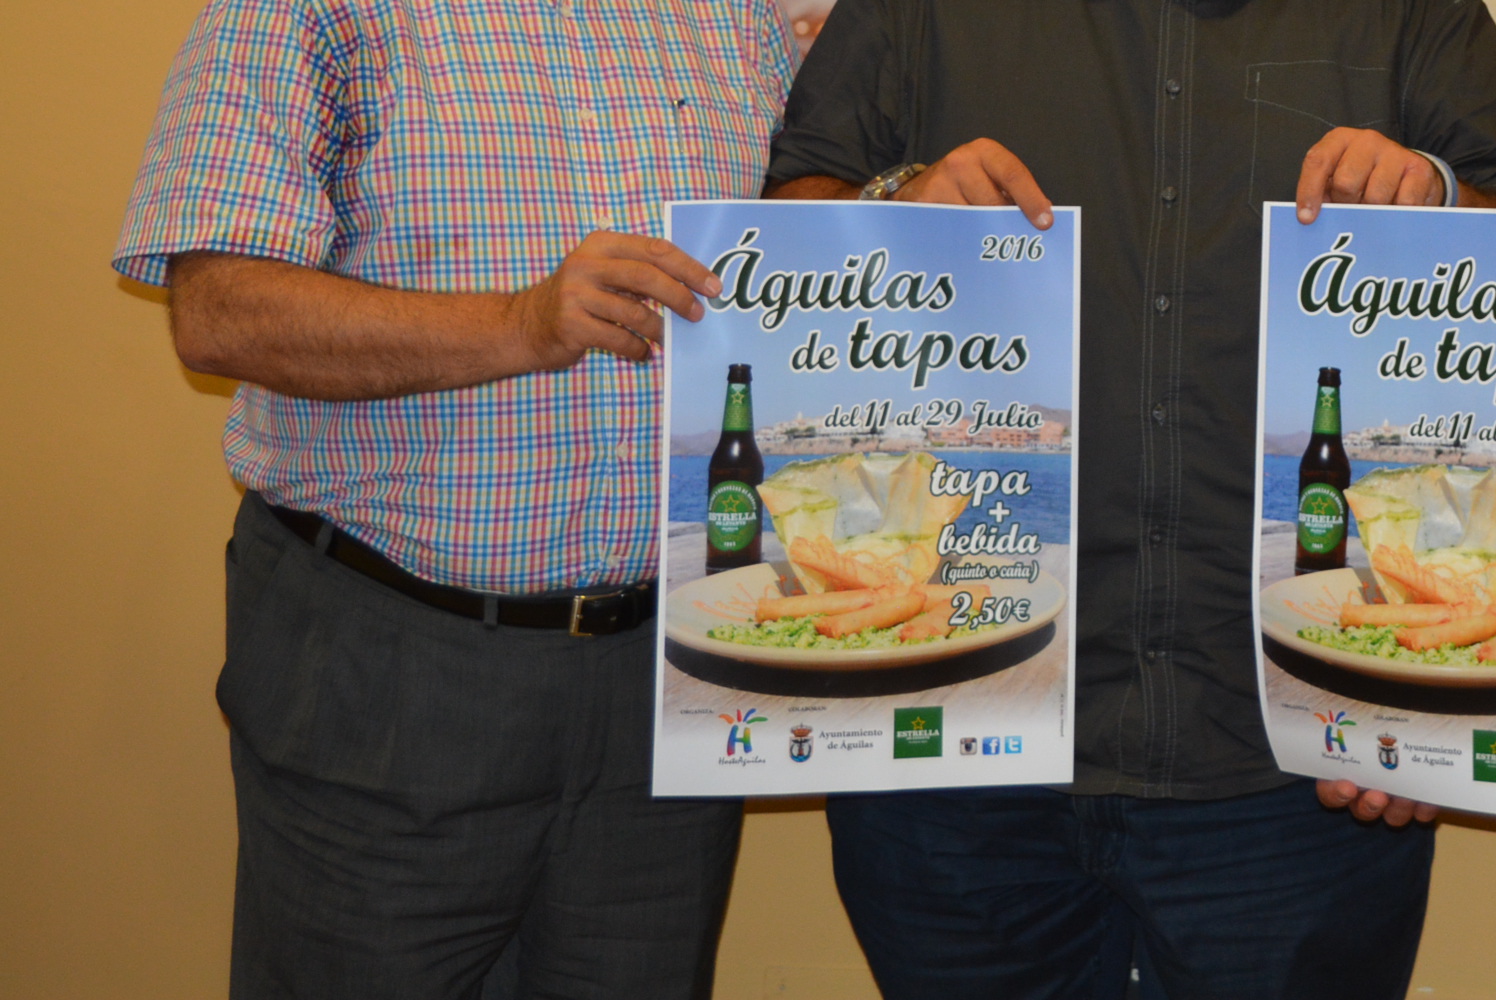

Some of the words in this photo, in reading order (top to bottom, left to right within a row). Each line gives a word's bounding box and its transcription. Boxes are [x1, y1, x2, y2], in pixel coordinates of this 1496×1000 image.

[980, 234, 1045, 262] 2016
[707, 227, 956, 331] Águilas
[789, 330, 838, 373] de
[848, 317, 1030, 389] tapas
[1378, 337, 1426, 379] de
[824, 405, 859, 428] del
[863, 400, 891, 430] 11
[896, 408, 920, 428] al
[926, 399, 963, 428] 29
[967, 399, 1043, 435] Julio
[1409, 414, 1444, 438] del
[1447, 412, 1475, 441] 11
[931, 461, 1031, 507] tapa
[988, 500, 1010, 523] +
[938, 523, 1041, 556] bebida
[942, 561, 987, 584] (quinto
[989, 567, 998, 579] o
[1000, 560, 1040, 583] caña)
[949, 592, 1031, 629] 2,50€
[819, 729, 883, 740] Ayuntamiento
[827, 741, 839, 749] de
[840, 740, 874, 751] Águilas
[896, 729, 940, 738] ESTRELLA
[1403, 742, 1462, 756] Ayuntamiento
[1411, 754, 1421, 763] de
[1423, 754, 1454, 767] Águilas
